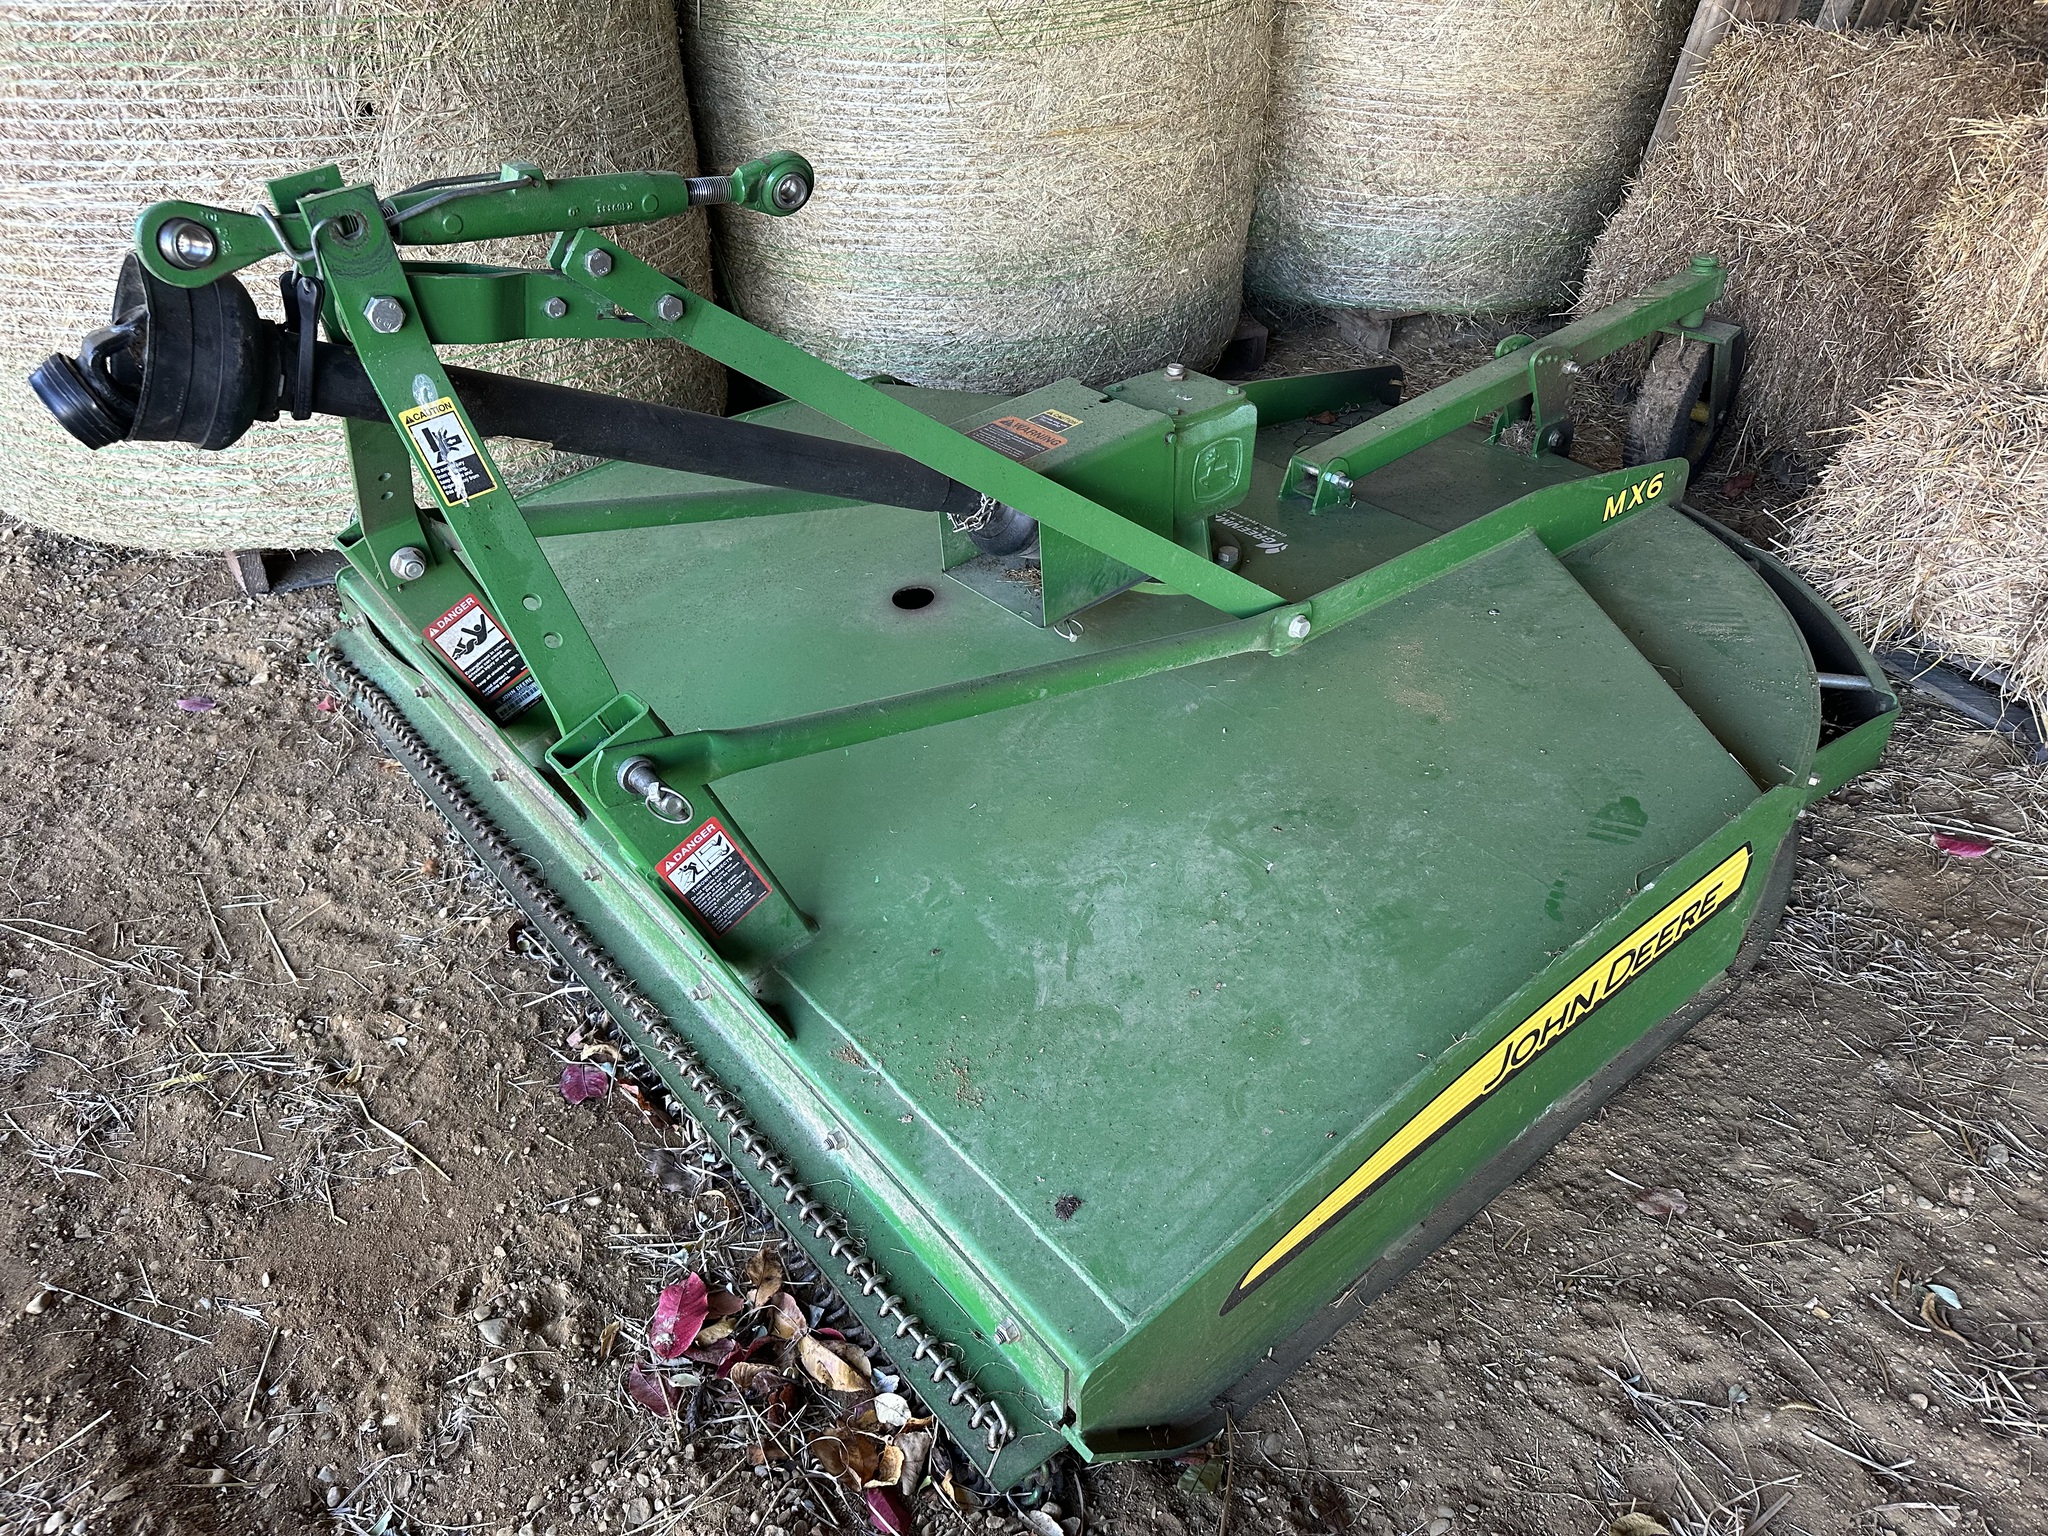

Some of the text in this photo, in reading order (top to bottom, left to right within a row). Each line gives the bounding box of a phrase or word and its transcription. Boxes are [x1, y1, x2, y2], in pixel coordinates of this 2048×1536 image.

[413, 401, 453, 421] CAUTION
[1013, 422, 1062, 446] WARNING
[1602, 471, 1665, 523] MX6
[437, 597, 475, 628] DANGER
[502, 676, 534, 701] JOHN DEERE
[673, 823, 716, 862] DANGER
[691, 856, 732, 892] THROWN OBJECTS
[712, 896, 734, 916] ROTATING
[734, 880, 752, 897] BLADES
[1483, 881, 1724, 1092] JOHN DEERE
